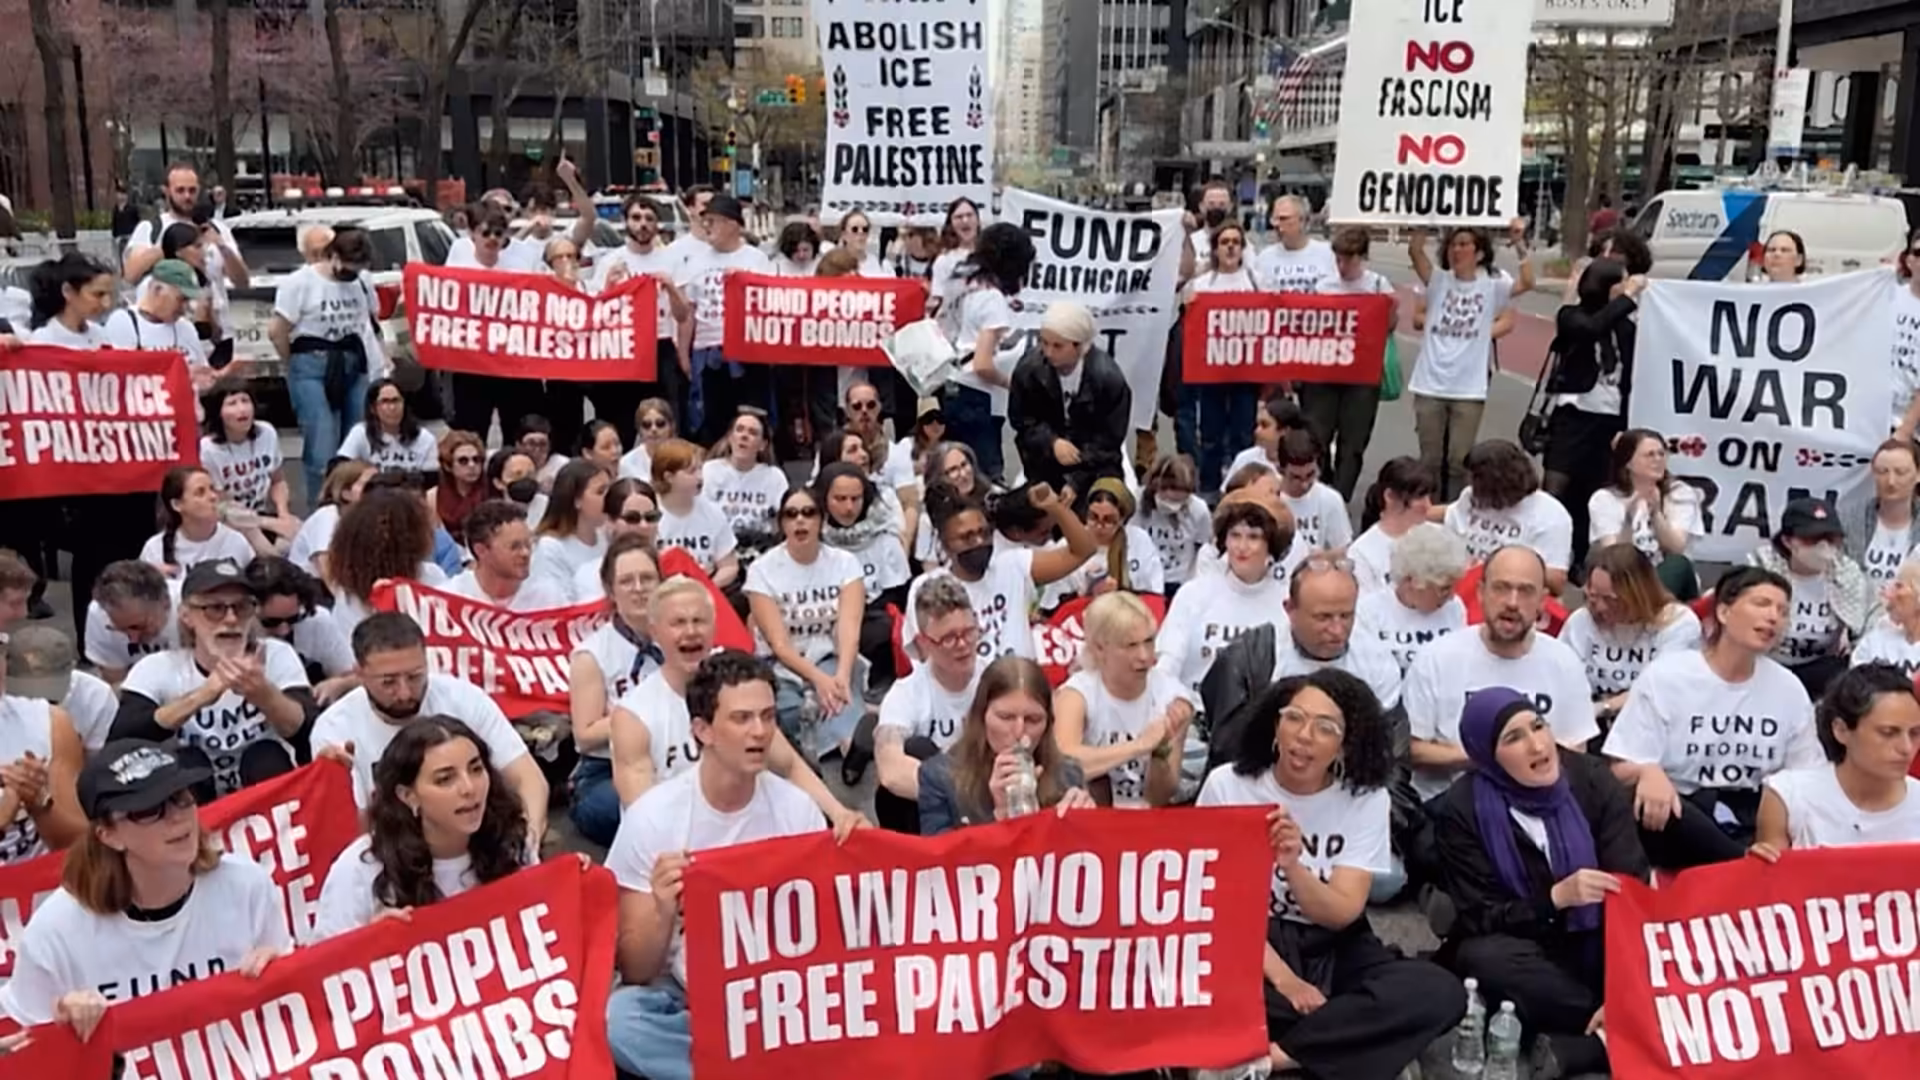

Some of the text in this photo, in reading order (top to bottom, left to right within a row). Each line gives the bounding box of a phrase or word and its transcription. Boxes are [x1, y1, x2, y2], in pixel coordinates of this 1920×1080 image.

[828, 21, 982, 51] ABOLISH
[879, 57, 932, 88] ICE
[1406, 40, 1475, 73] NO
[1379, 77, 1492, 122] FASCISM
[866, 106, 950, 138] FREE
[833, 143, 985, 187] PALESTINE
[1398, 135, 1465, 165] NO
[1359, 170, 1502, 217] GENOCIDE
[1022, 209, 1162, 262] FUND
[1026, 263, 1152, 294] EALTHCARE
[417, 274, 635, 330] NO WAR NO ICE
[745, 286, 808, 316] FUND
[811, 288, 896, 321] PEOPLE
[415, 313, 636, 360] FREE PALESTINE
[744, 315, 895, 348] NOT BOMBS
[1207, 307, 1359, 337] FUND PEOPLE
[1710, 299, 1816, 362] NO
[1206, 335, 1356, 366] NOT BOMBS
[78, 372, 119, 416] NO
[124, 374, 175, 417] ICE
[1672, 358, 1848, 430] WAR
[23, 419, 180, 464] PALESTINE
[1718, 437, 1782, 472] ON
[222, 454, 271, 479] FUND
[1676, 474, 1838, 539] RA
[1869, 549, 1901, 566] UN
[783, 585, 840, 604] FUND
[395, 584, 462, 637] NO
[461, 604, 564, 651] WAR
[427, 644, 506, 694] REE
[1585, 665, 1639, 681] PEOP
[196, 698, 259, 730] UND
[1690, 714, 1778, 737] FUND
[1686, 742, 1776, 761] PEOPLE
[1698, 764, 1762, 782] NOT
[720, 877, 817, 969] NO
[836, 863, 1001, 949] WAR
[1014, 851, 1102, 934] NO
[1121, 848, 1219, 927] ICE
[1642, 890, 1920, 988] FUND PEO
[323, 902, 569, 1051] PEOPLE
[726, 932, 1213, 1060] FREE PALESTINE
[1654, 960, 1920, 1067] NOT BOM
